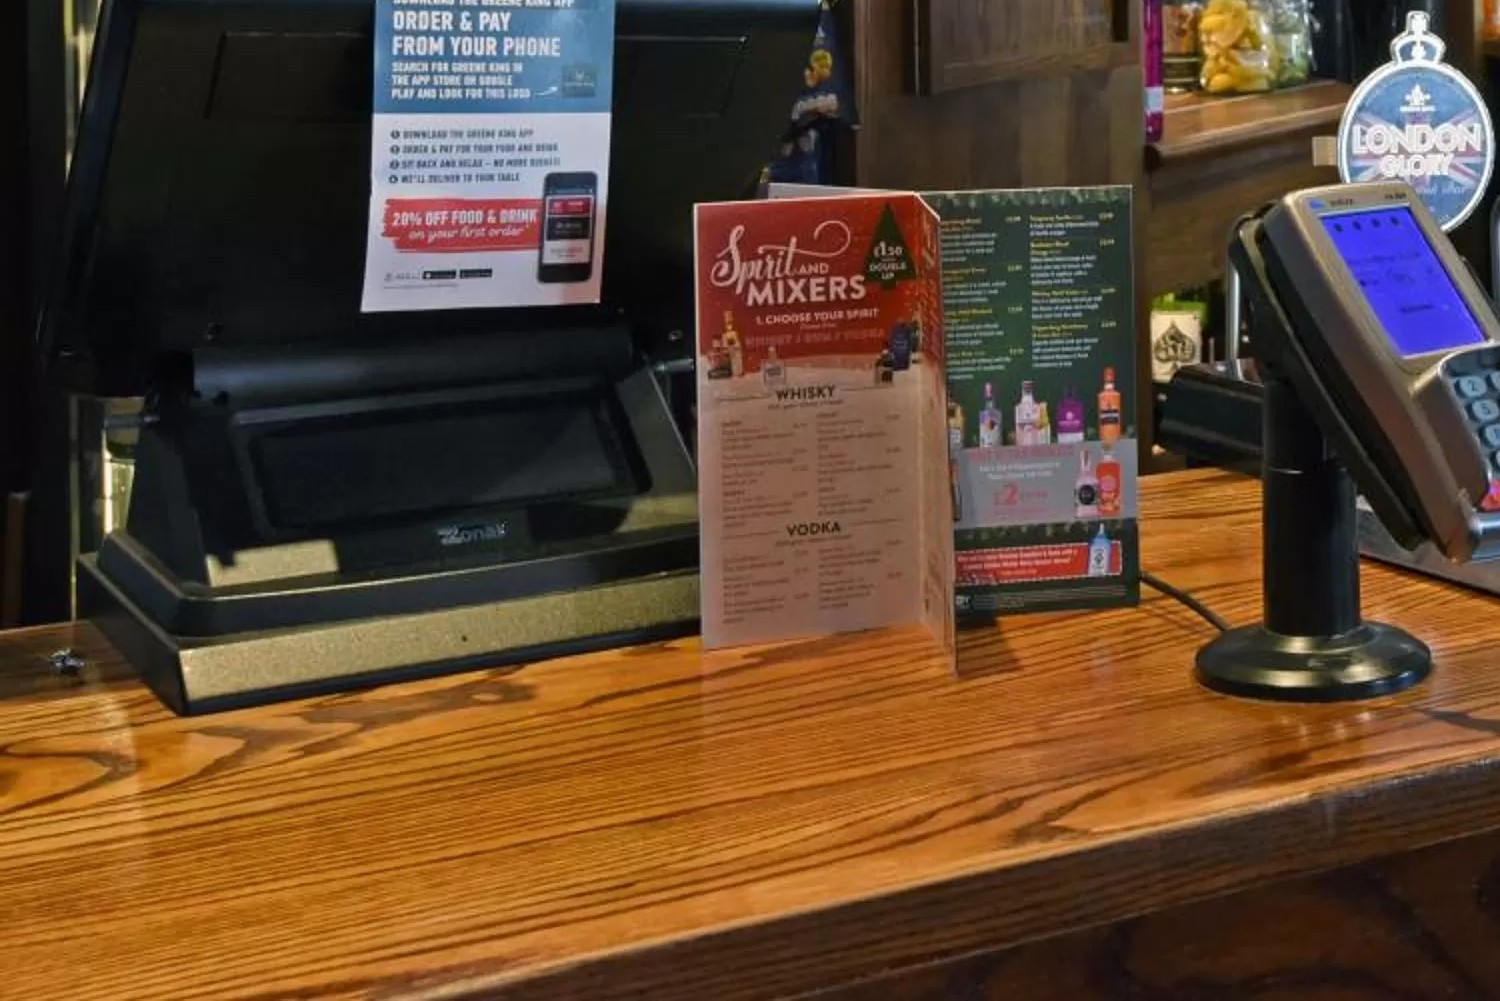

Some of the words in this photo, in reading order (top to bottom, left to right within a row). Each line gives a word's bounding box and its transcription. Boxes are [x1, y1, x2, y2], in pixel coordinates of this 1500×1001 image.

[393, 10, 454, 31] ORDER
[459, 11, 474, 32] &
[479, 11, 512, 31] PAY
[392, 35, 445, 56] FROM
[450, 36, 498, 56] YOUR
[503, 37, 561, 57] PHONE
[412, 74, 431, 85] APP
[391, 88, 414, 99] PLAY
[1351, 122, 1482, 154] LONDON
[1379, 155, 1455, 178] GLORY
[392, 212, 422, 227] 20%
[425, 210, 448, 226] OFF
[451, 210, 483, 225] FOOD
[487, 210, 497, 224] &
[500, 208, 538, 223] DRINK
[408, 230, 425, 240] on
[427, 228, 458, 244] your
[459, 225, 485, 241] first
[710, 225, 801, 296] Spirit
[799, 262, 829, 275] AND
[869, 262, 907, 273] DOUBLE
[746, 274, 866, 307] MIXERS
[765, 313, 811, 326] CHOOSE
[813, 310, 844, 322] YOUR
[846, 307, 880, 320] SPIRIT
[775, 384, 836, 401] WHISKY
[786, 521, 842, 538] VODKA
